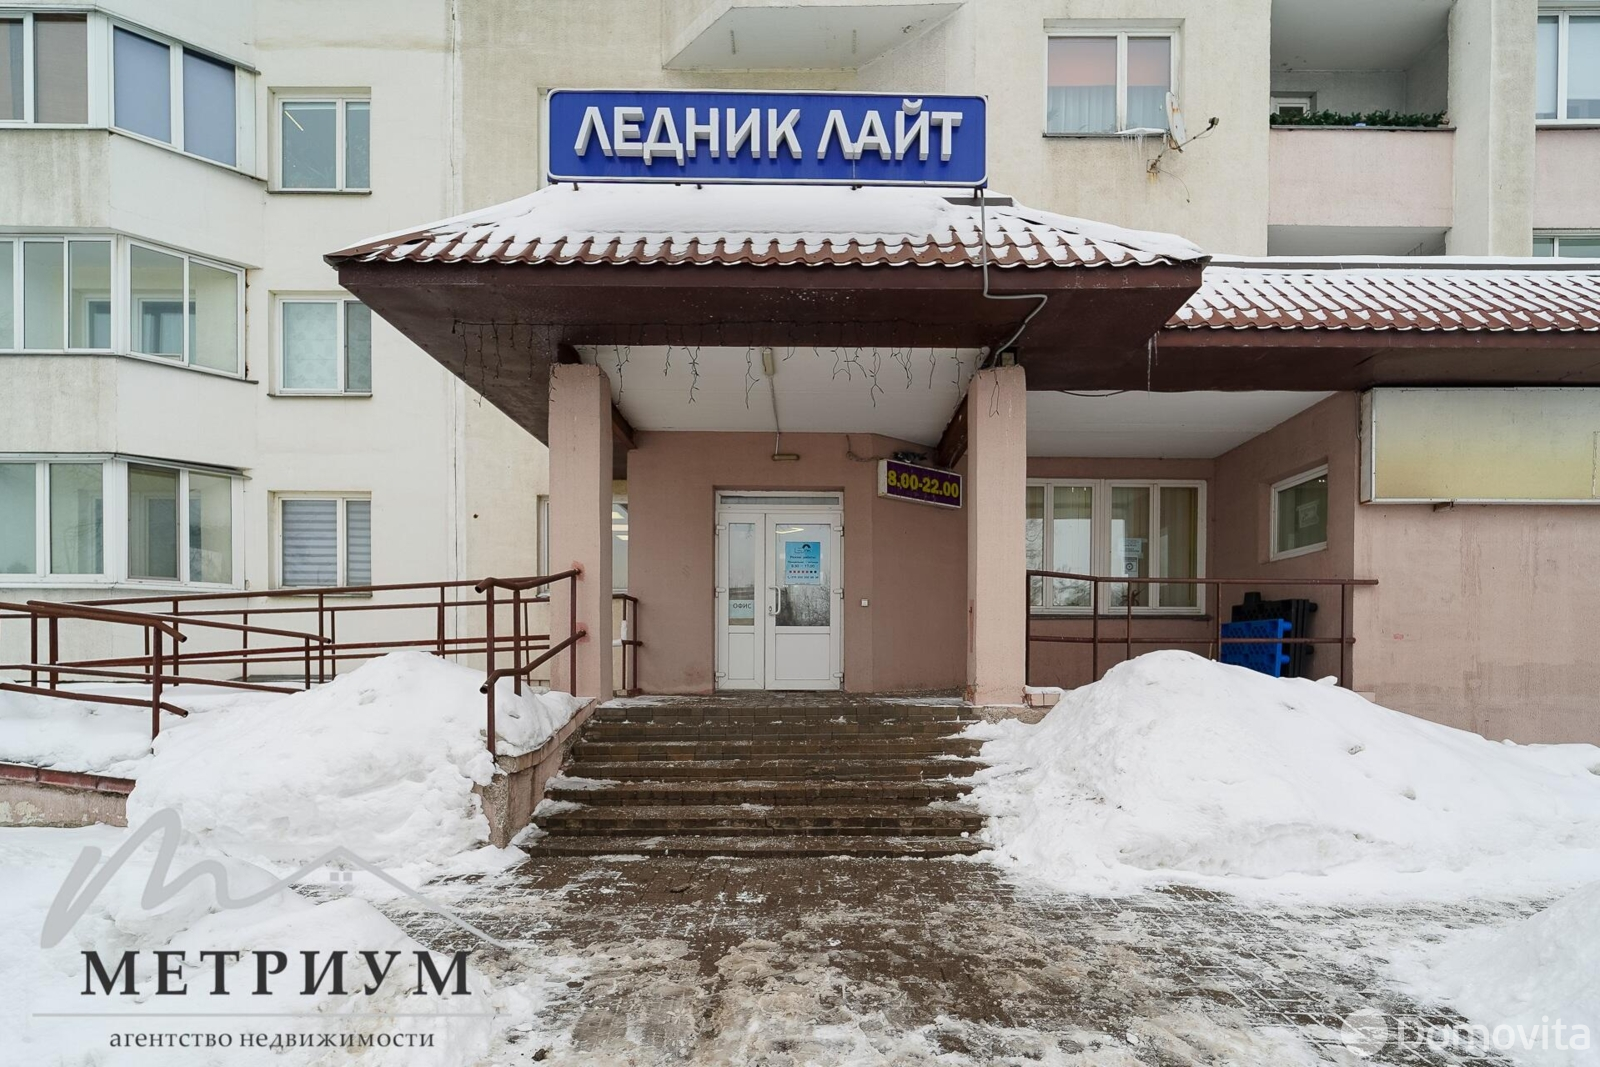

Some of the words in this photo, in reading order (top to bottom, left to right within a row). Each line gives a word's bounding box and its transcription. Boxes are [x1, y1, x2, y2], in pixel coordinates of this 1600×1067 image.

[574, 106, 802, 166] ЛЕДНИК
[817, 99, 963, 161] ЛАЙТ
[887, 470, 959, 498] 8.00-22.00
